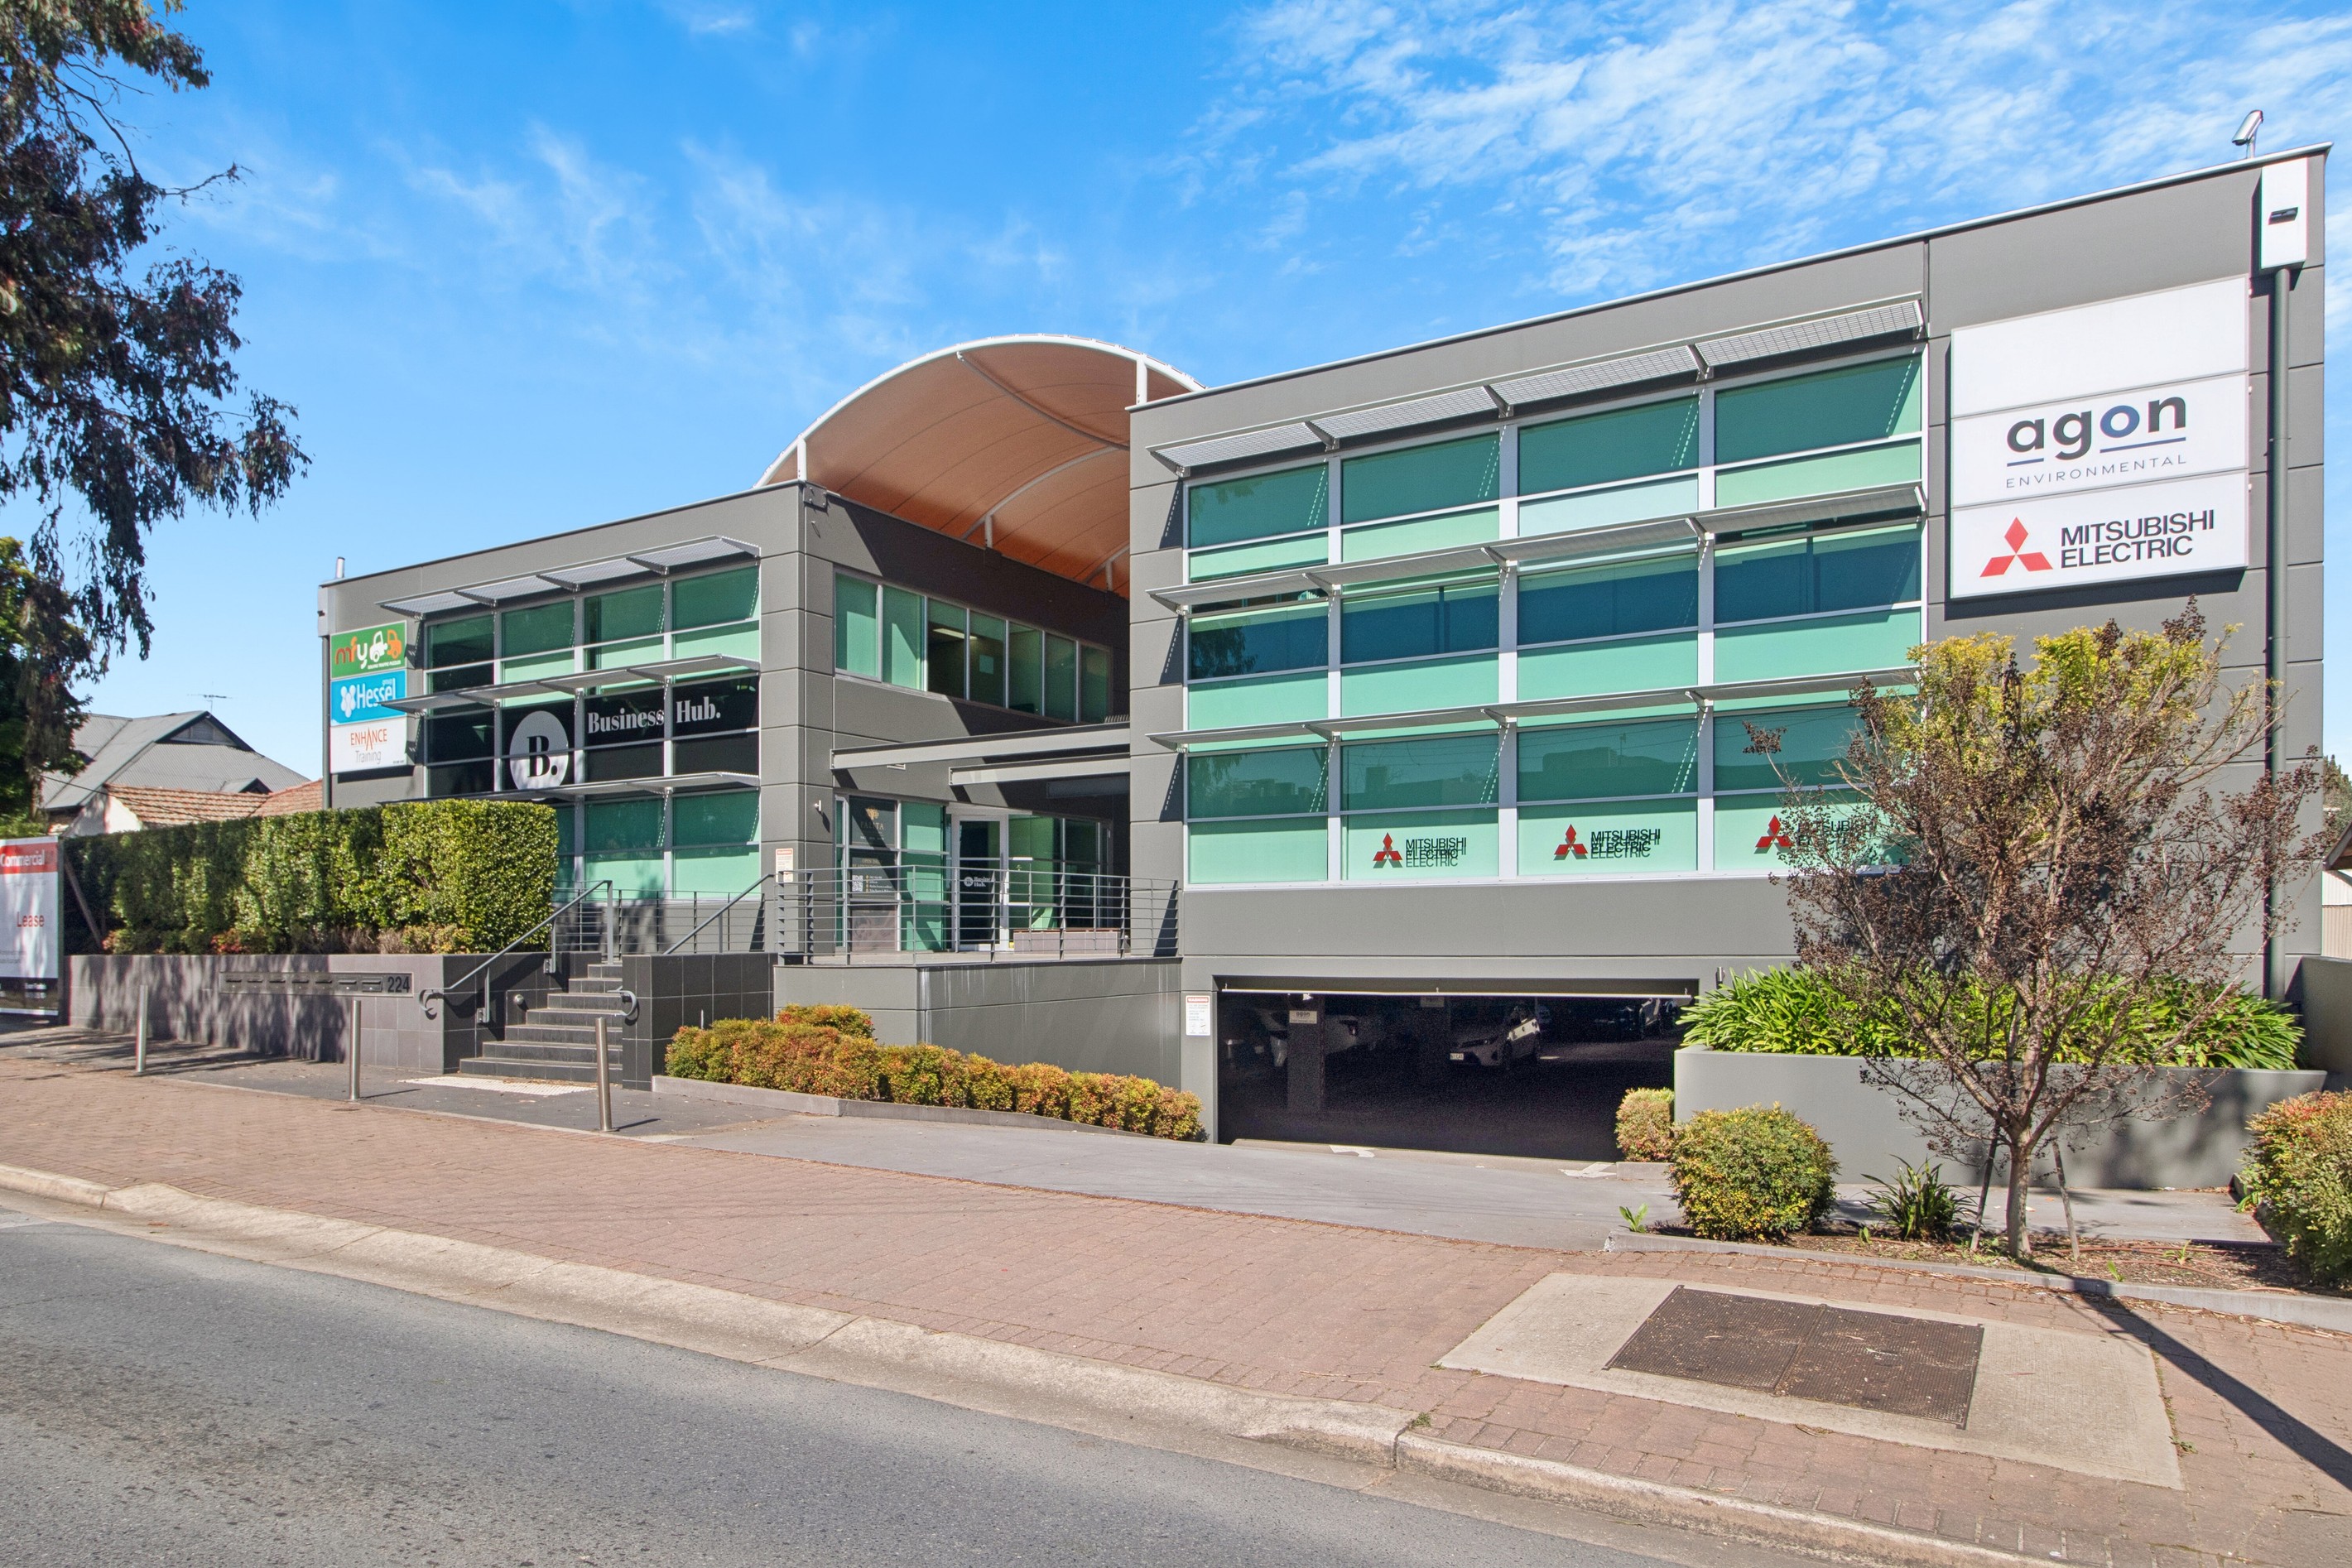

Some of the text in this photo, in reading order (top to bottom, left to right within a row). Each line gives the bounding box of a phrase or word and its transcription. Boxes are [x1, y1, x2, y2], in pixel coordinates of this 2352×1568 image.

[2007, 397, 2186, 460] agon
[2006, 455, 2186, 488] ENVIRONMENTAL
[2061, 509, 2214, 546] MITSUBISHI
[2061, 536, 2192, 569] ELECTRIC
[357, 678, 396, 709] Hessel
[588, 696, 721, 734] Business Hub.
[351, 727, 387, 751] ENHANCE
[355, 750, 382, 765] Training
[1406, 837, 1466, 849] MITSUBISHI
[1591, 829, 1661, 842] MITSUBISHI
[1406, 849, 1458, 860] ELECTRIC
[1591, 840, 1652, 854] ELECTRIC
[0, 849, 45, 867] Commercial
[17, 911, 45, 927] Lease
[387, 976, 410, 993] 224
